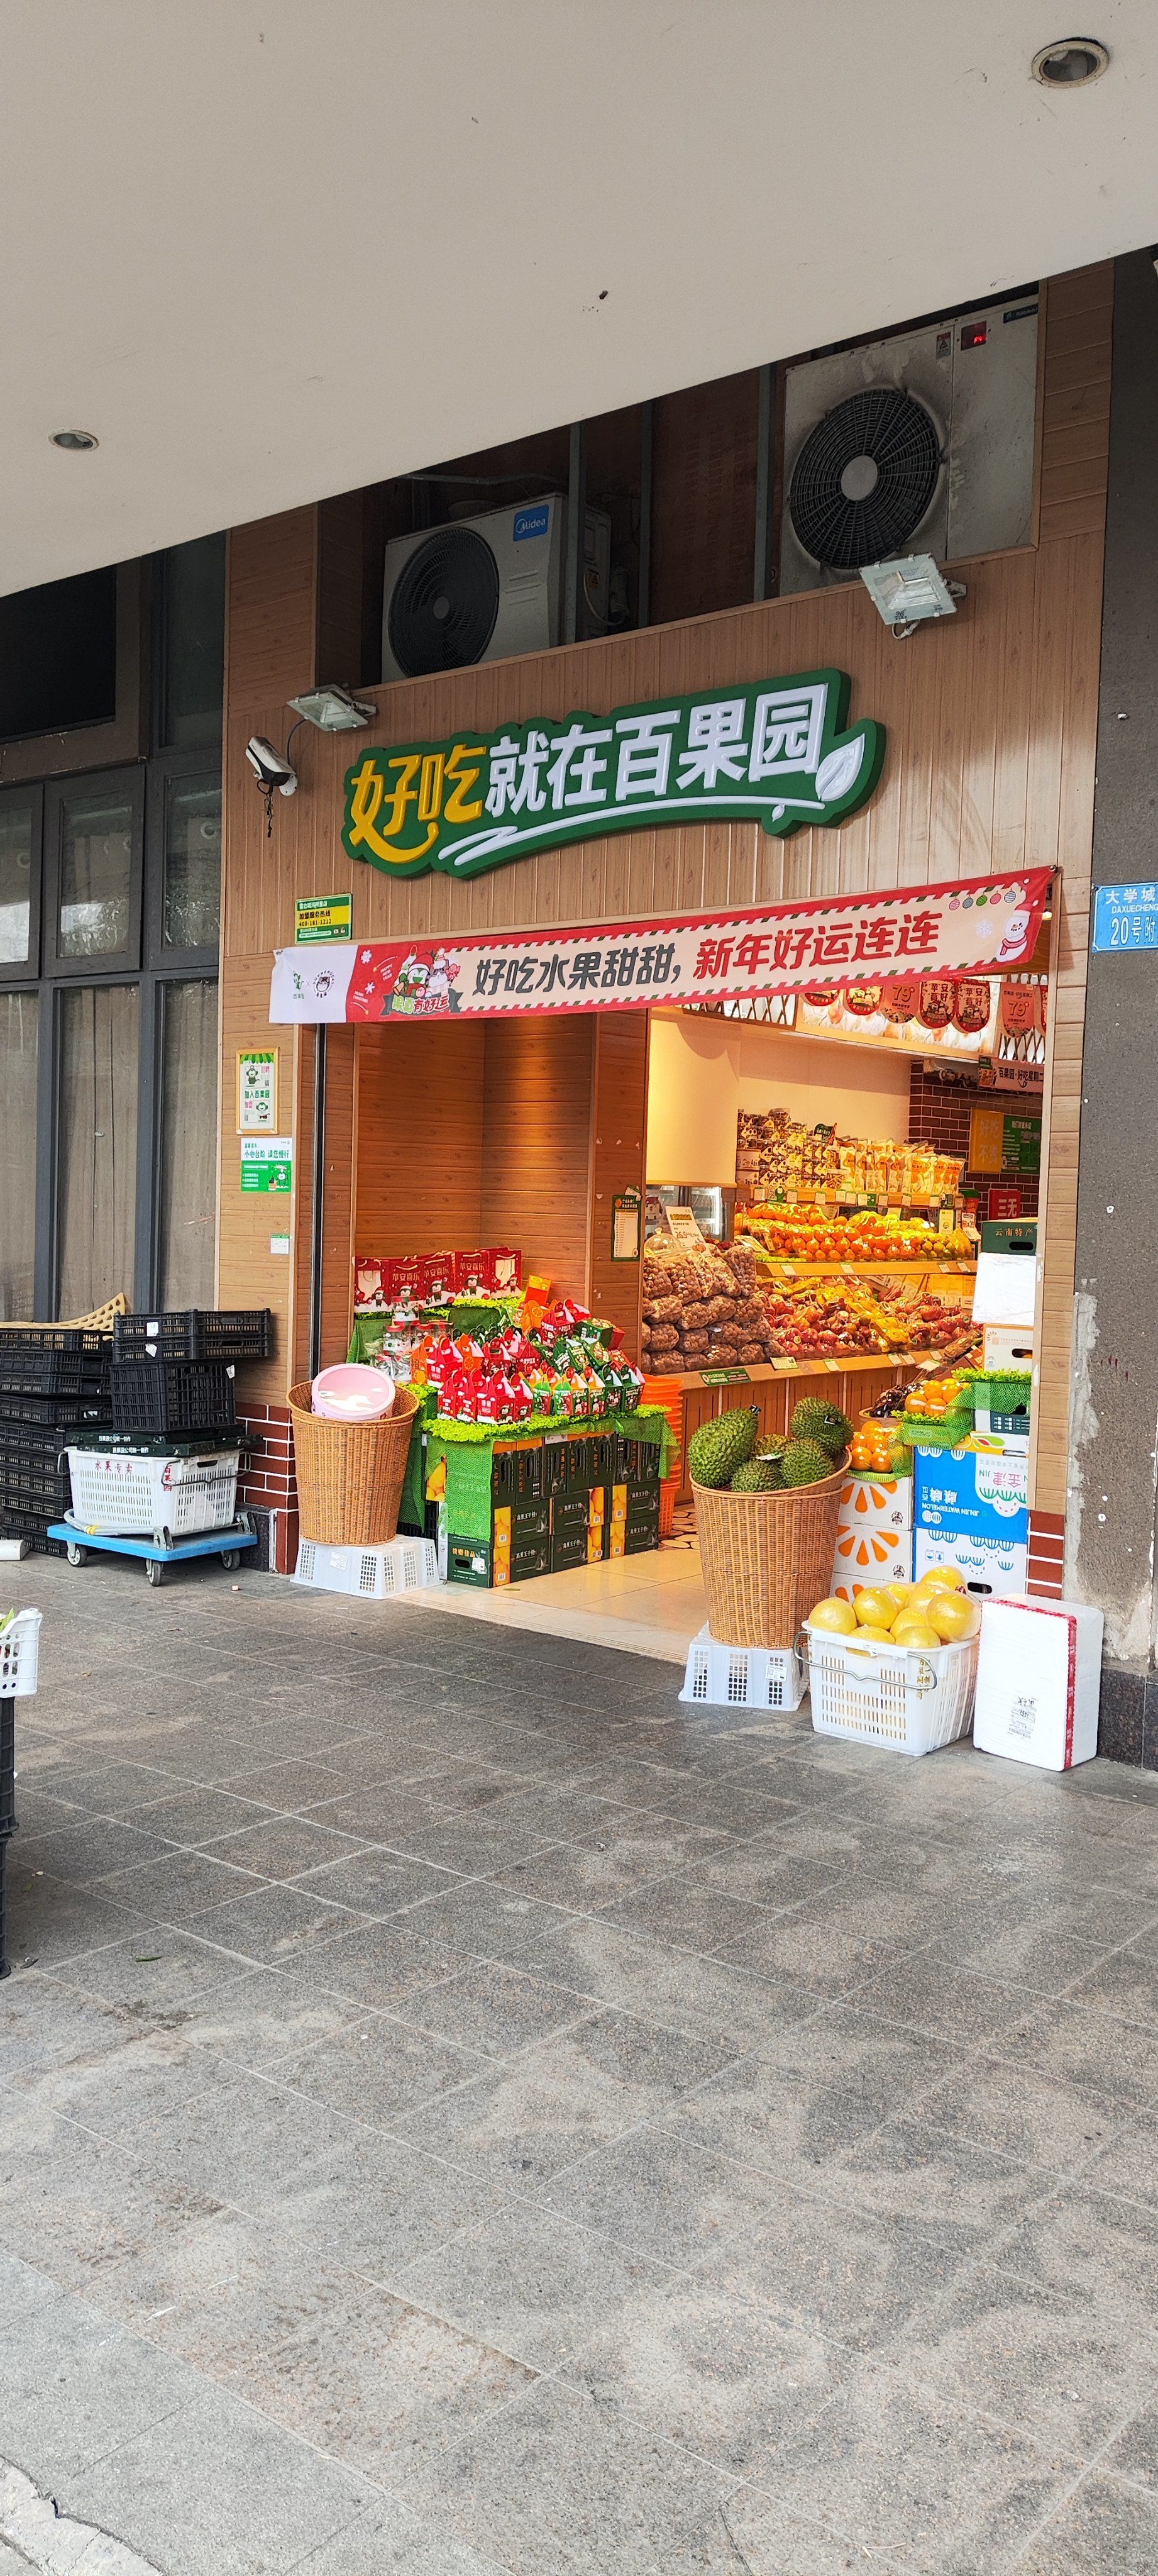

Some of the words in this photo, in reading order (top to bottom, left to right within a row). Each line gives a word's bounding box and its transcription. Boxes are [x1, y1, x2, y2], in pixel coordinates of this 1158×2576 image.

[516, 518, 546, 533] Midea
[348, 682, 829, 863] 好吃就在百果园
[1106, 887, 1156, 905] 大学城
[1110, 915, 1156, 946] 20号附
[245, 1090, 270, 1099] 加入百果园
[244, 1150, 265, 1159] 小心台阶
[268, 1149, 290, 1159] 请您慢行
[995, 1228, 1034, 1237] 云南特产
[95, 1459, 133, 1475] 水果专卖
[163, 1465, 172, 1492] 百果园
[993, 1472, 1021, 1488] 金津
[922, 1502, 961, 1514] WATERMELON
[961, 1507, 980, 1516] JINJIN
